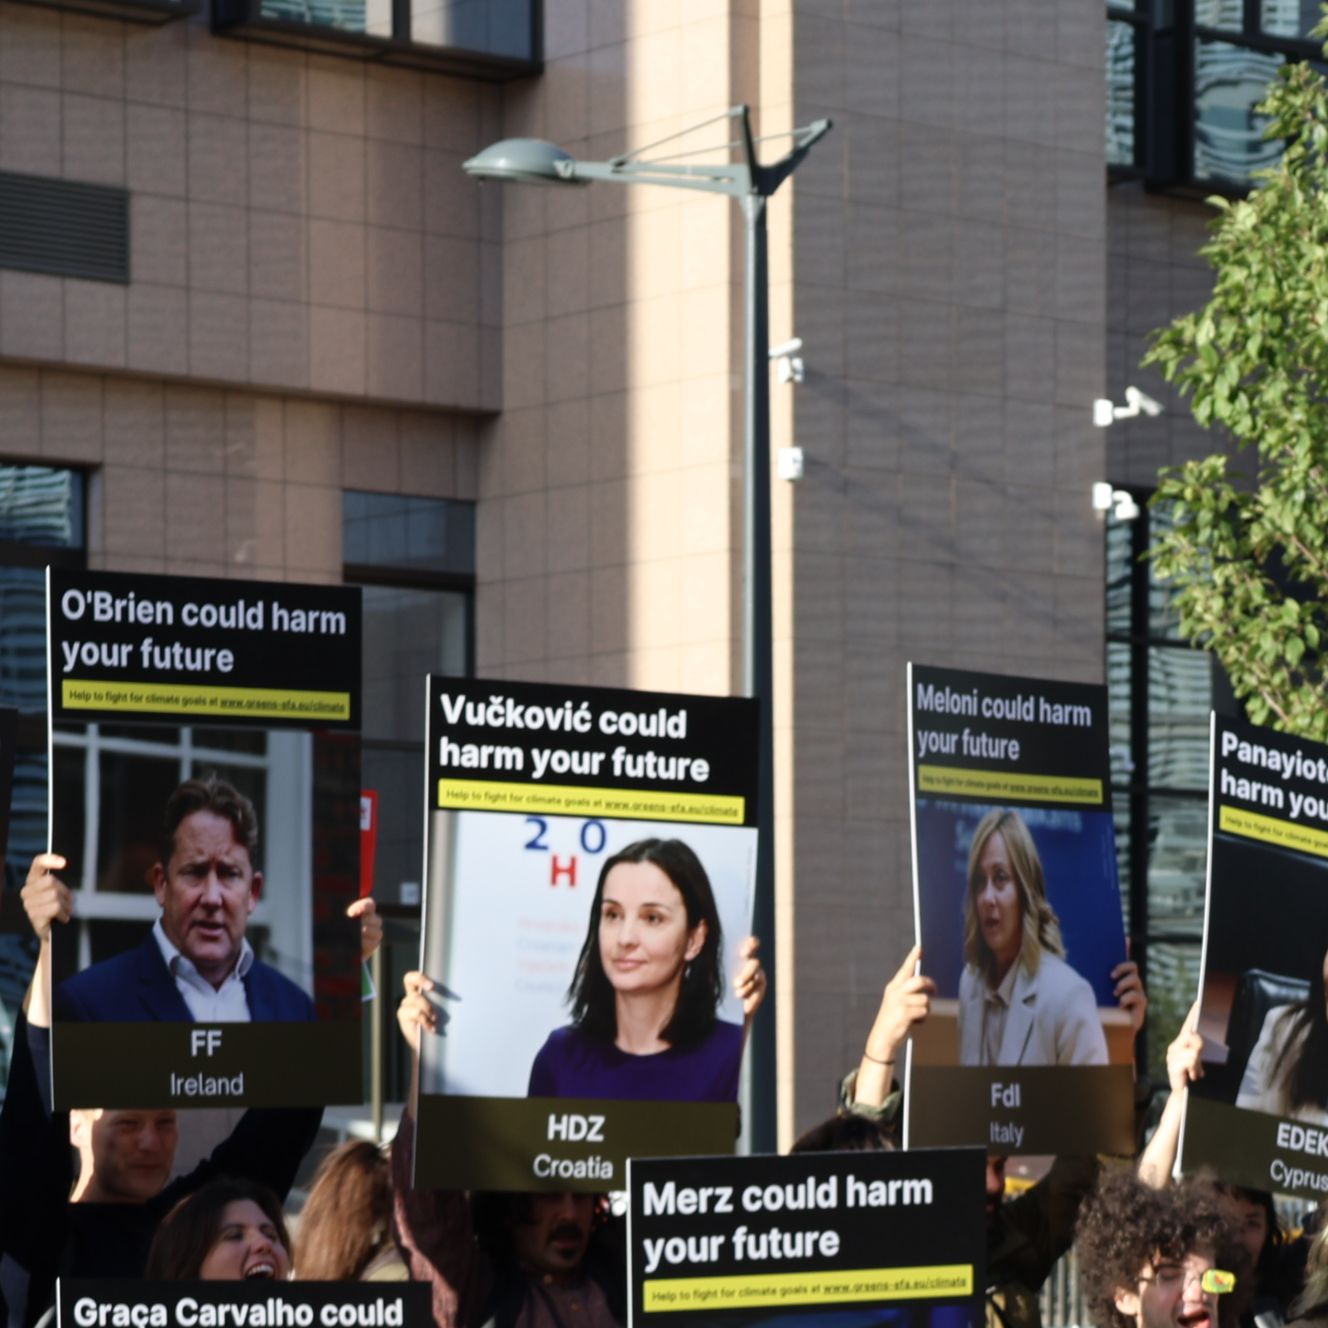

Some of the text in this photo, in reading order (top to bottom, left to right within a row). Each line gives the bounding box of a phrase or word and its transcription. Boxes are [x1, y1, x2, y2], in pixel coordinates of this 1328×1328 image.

[61, 588, 346, 635] O'Brien could harm
[440, 693, 687, 739] Vučković could
[916, 682, 1092, 727] Meloni could harm
[191, 1029, 223, 1057] FF
[170, 1072, 244, 1096] Ireland
[547, 1113, 606, 1142] HDZ
[989, 1121, 1025, 1149] Italy
[533, 1153, 614, 1180] Croatia
[643, 1175, 933, 1216] Merz could harm
[175, 1297, 314, 1327] Carvalho
[320, 1297, 404, 1327] could
